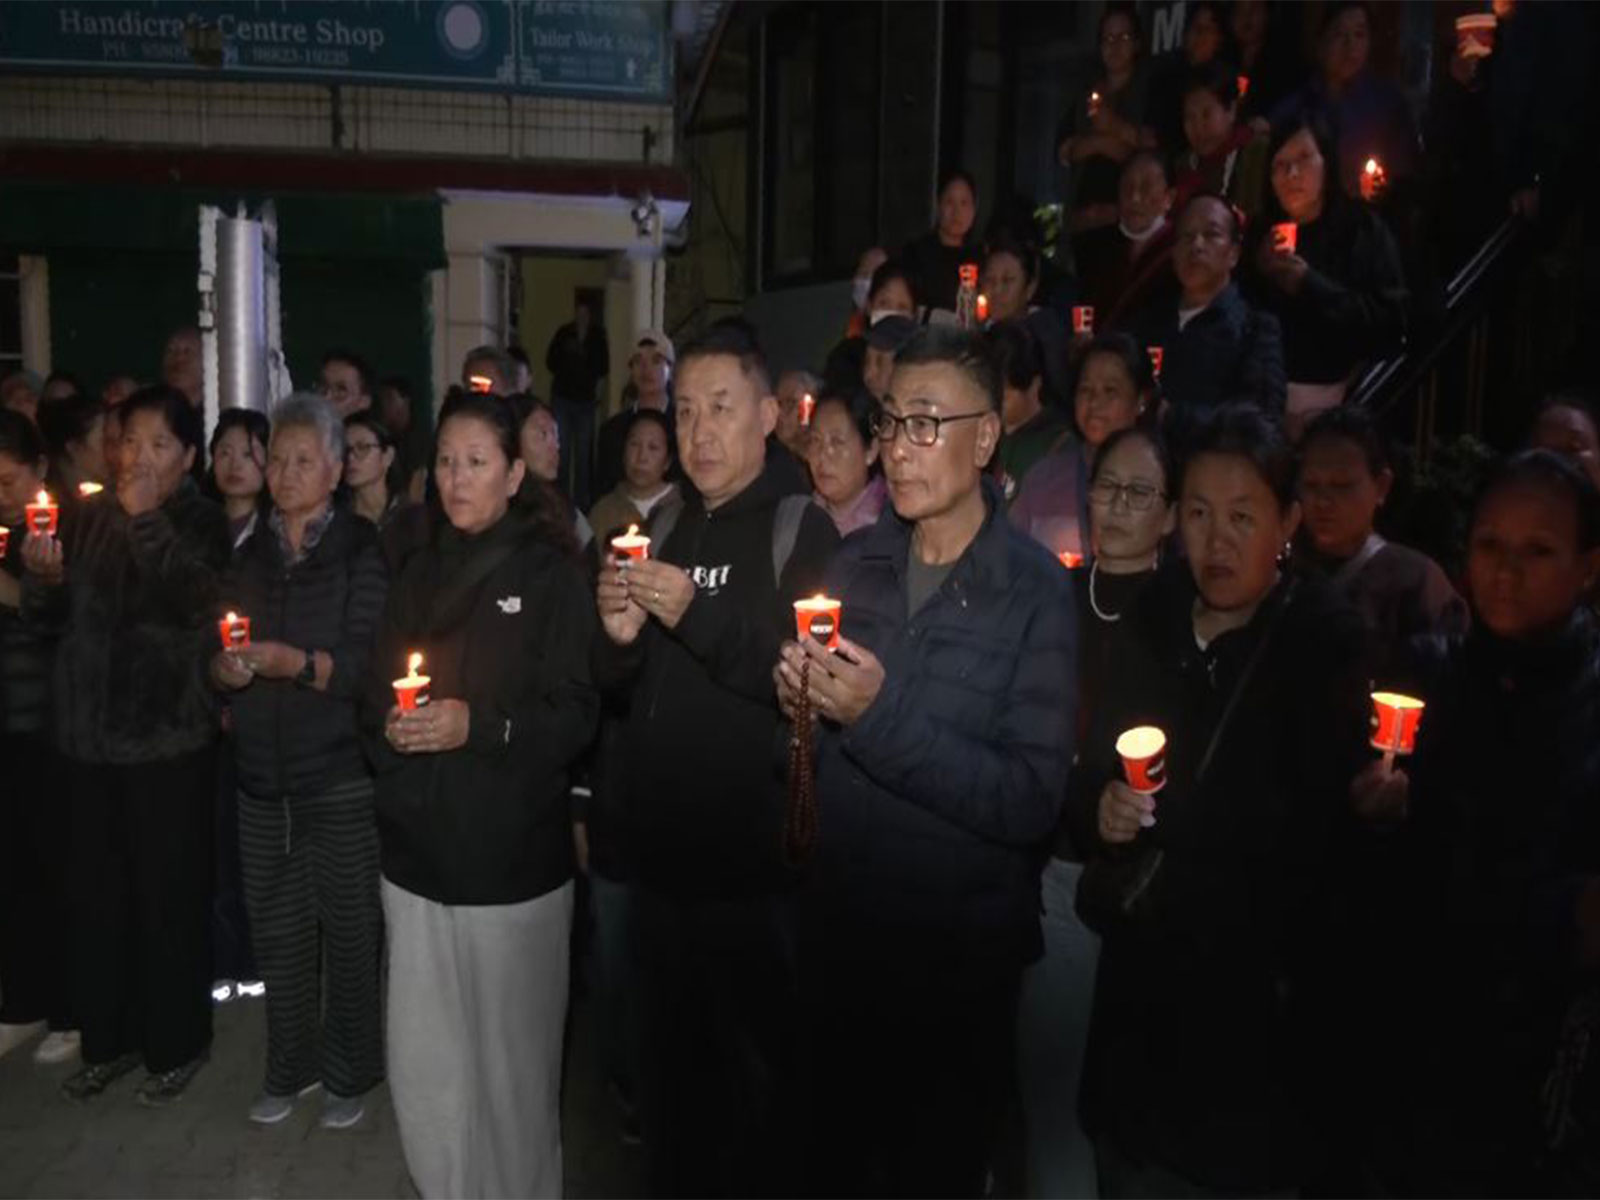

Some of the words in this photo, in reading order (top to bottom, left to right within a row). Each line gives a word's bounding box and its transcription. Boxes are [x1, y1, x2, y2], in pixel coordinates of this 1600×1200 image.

[217, 14, 307, 42] Centre
[316, 18, 385, 54] Shop
[530, 27, 572, 47] Tailor
[575, 30, 613, 50] Work
[1151, 1, 1187, 56] M
